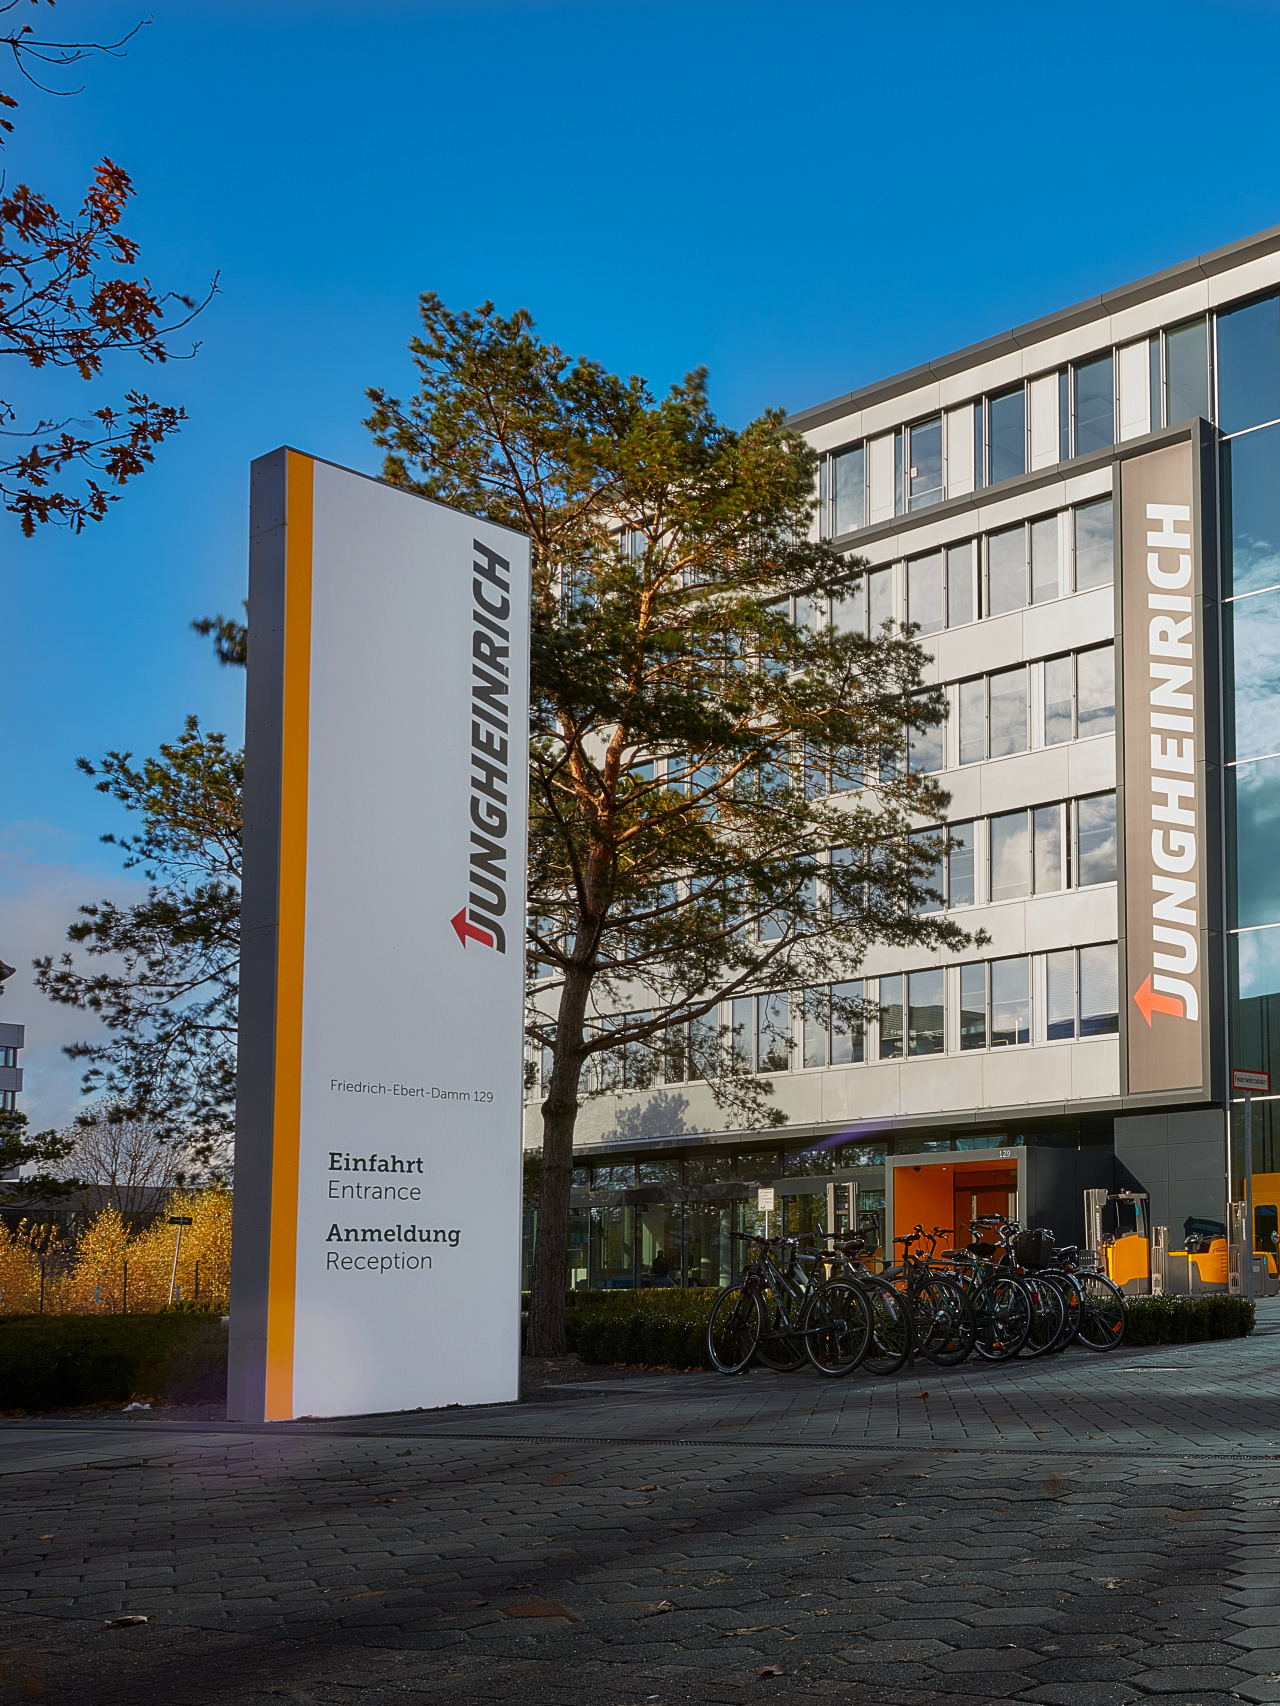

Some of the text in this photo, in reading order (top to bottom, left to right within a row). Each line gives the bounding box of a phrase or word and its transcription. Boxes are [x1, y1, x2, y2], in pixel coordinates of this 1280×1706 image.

[469, 538, 511, 955] JUNGHEINRICH
[1146, 503, 1199, 1022] JUNGHEINRICH
[330, 1079, 494, 1102] Friedrich-Ebert-Damm 129
[328, 1152, 424, 1174] Einfahrt
[999, 1149, 1011, 1158] 129
[328, 1180, 422, 1201] Entrance
[325, 1223, 461, 1247] Anmeldung
[326, 1251, 432, 1274] Reception
